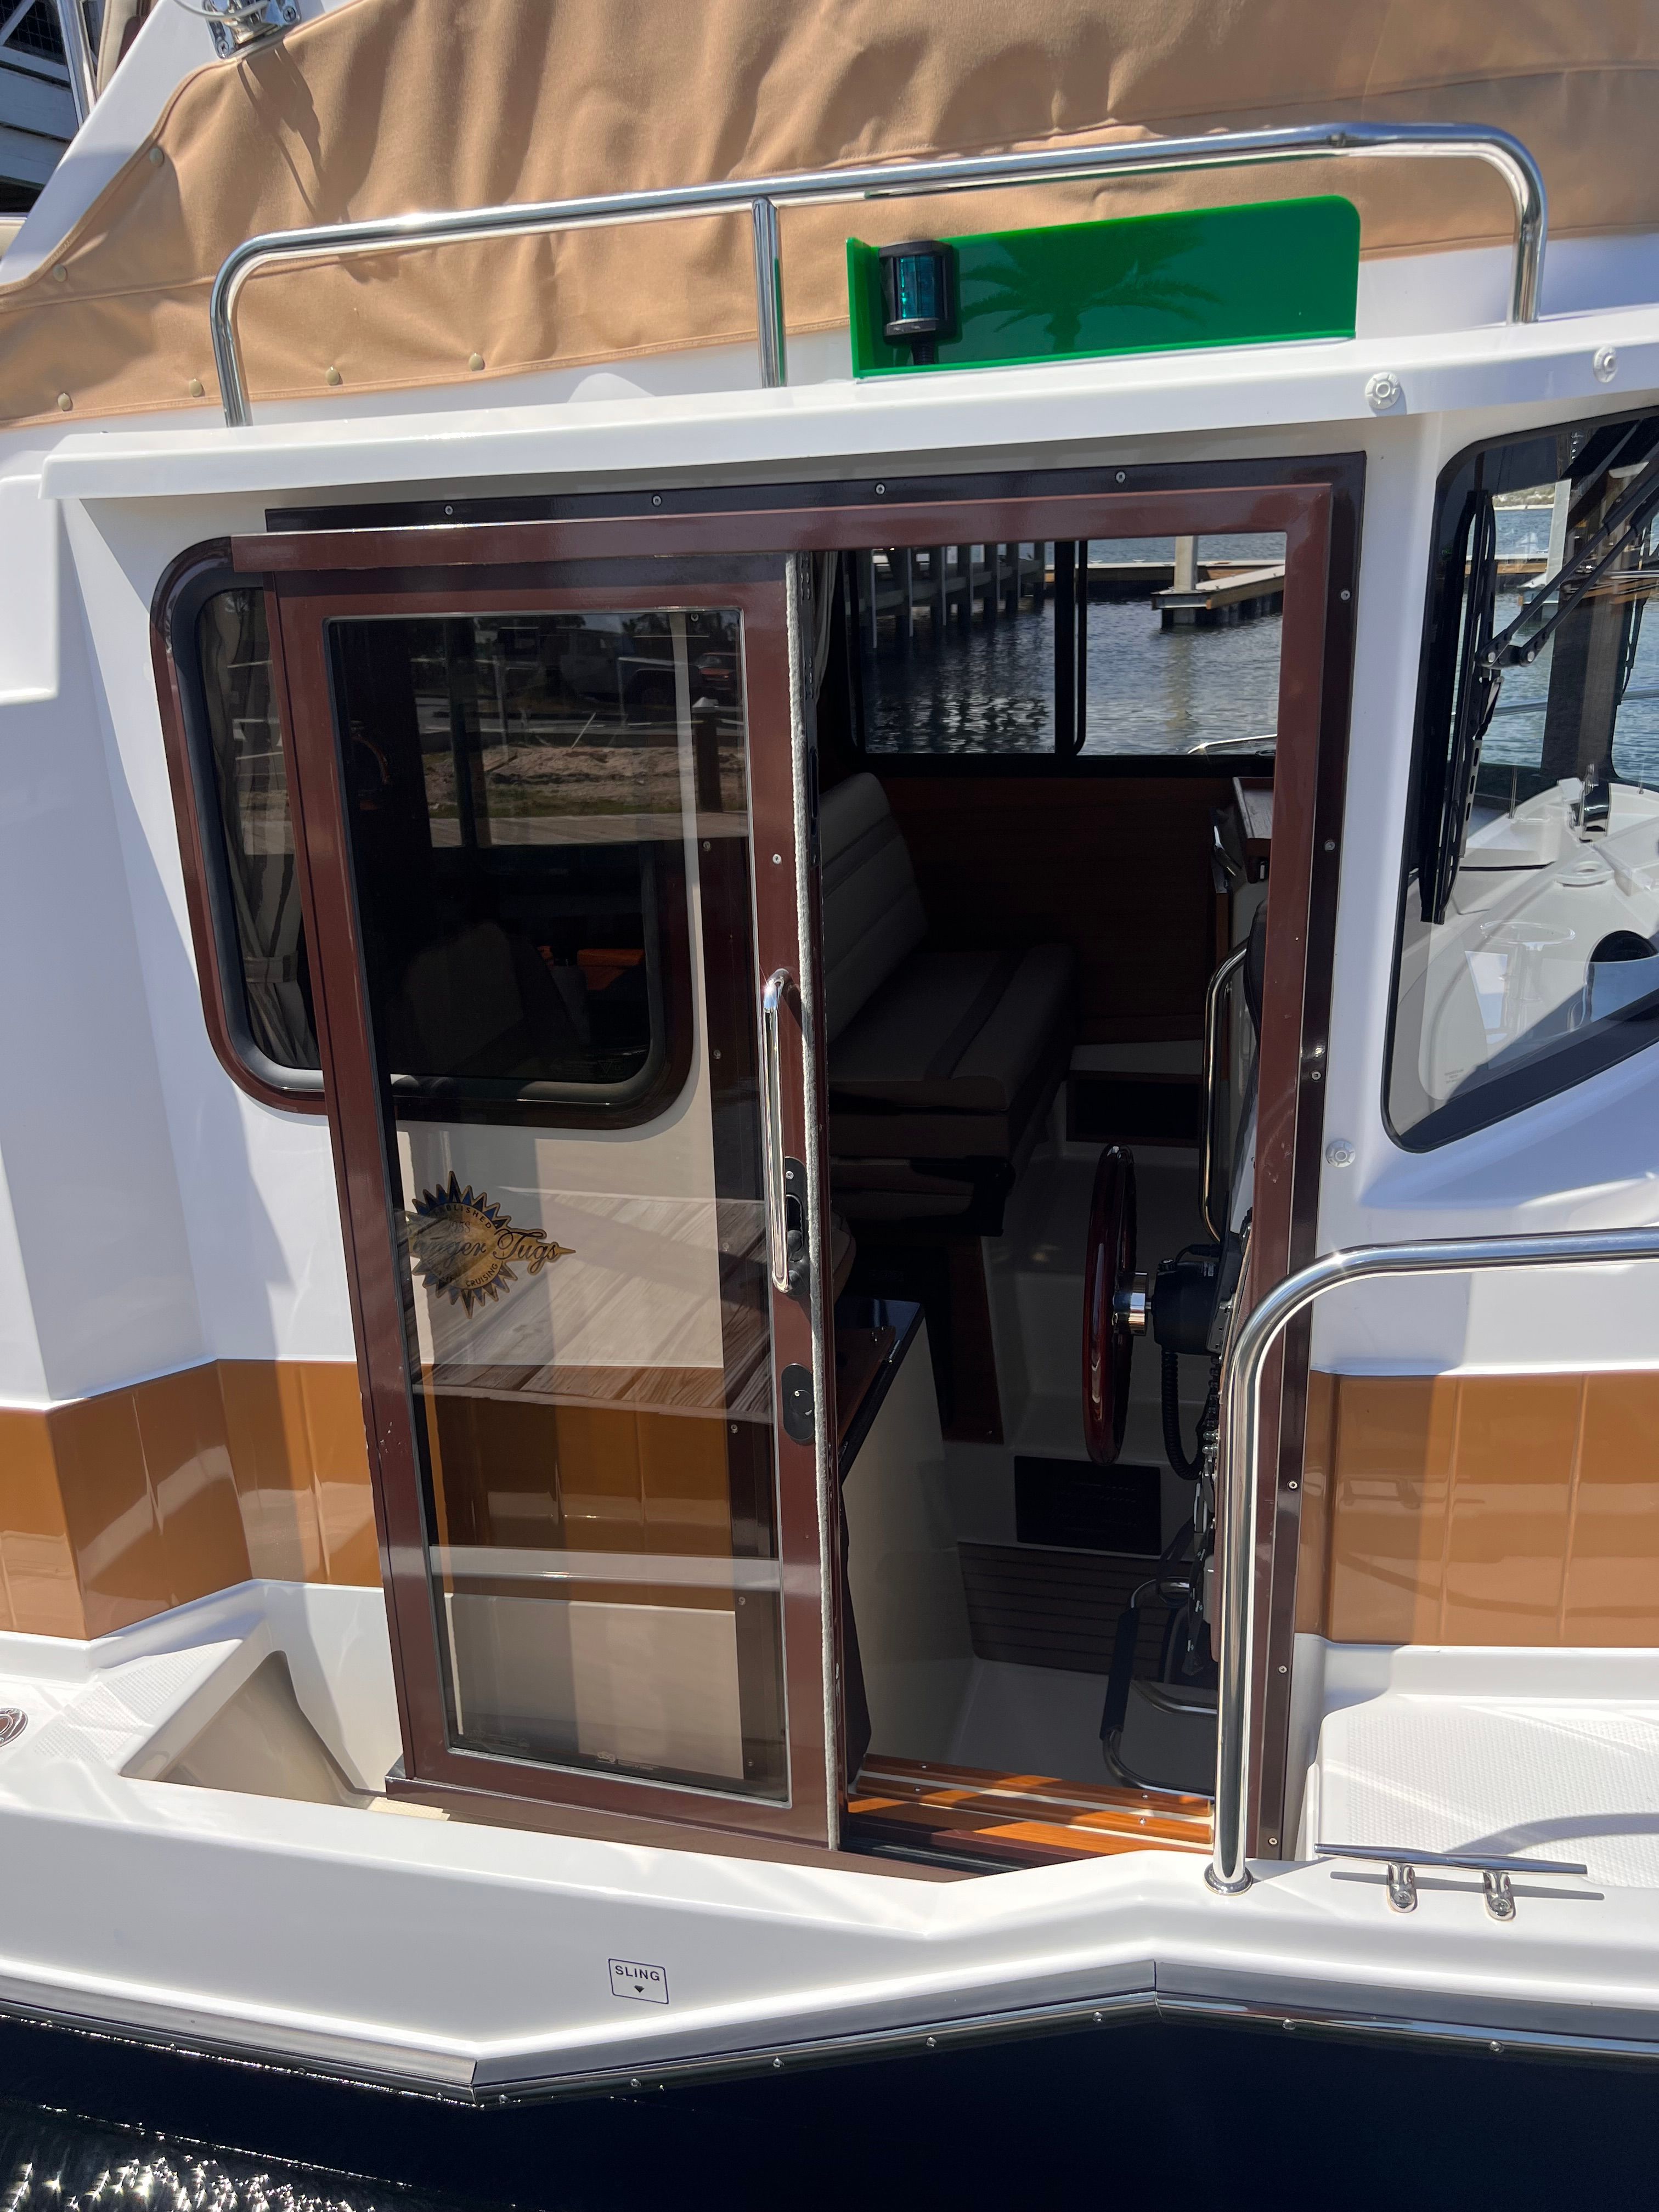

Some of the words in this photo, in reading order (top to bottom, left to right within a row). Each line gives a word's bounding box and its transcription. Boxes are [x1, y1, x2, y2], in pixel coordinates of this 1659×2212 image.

[494, 1228, 558, 1273] Tugs
[465, 1263, 498, 1287] CRUISING
[615, 1965, 660, 1981] SLING
